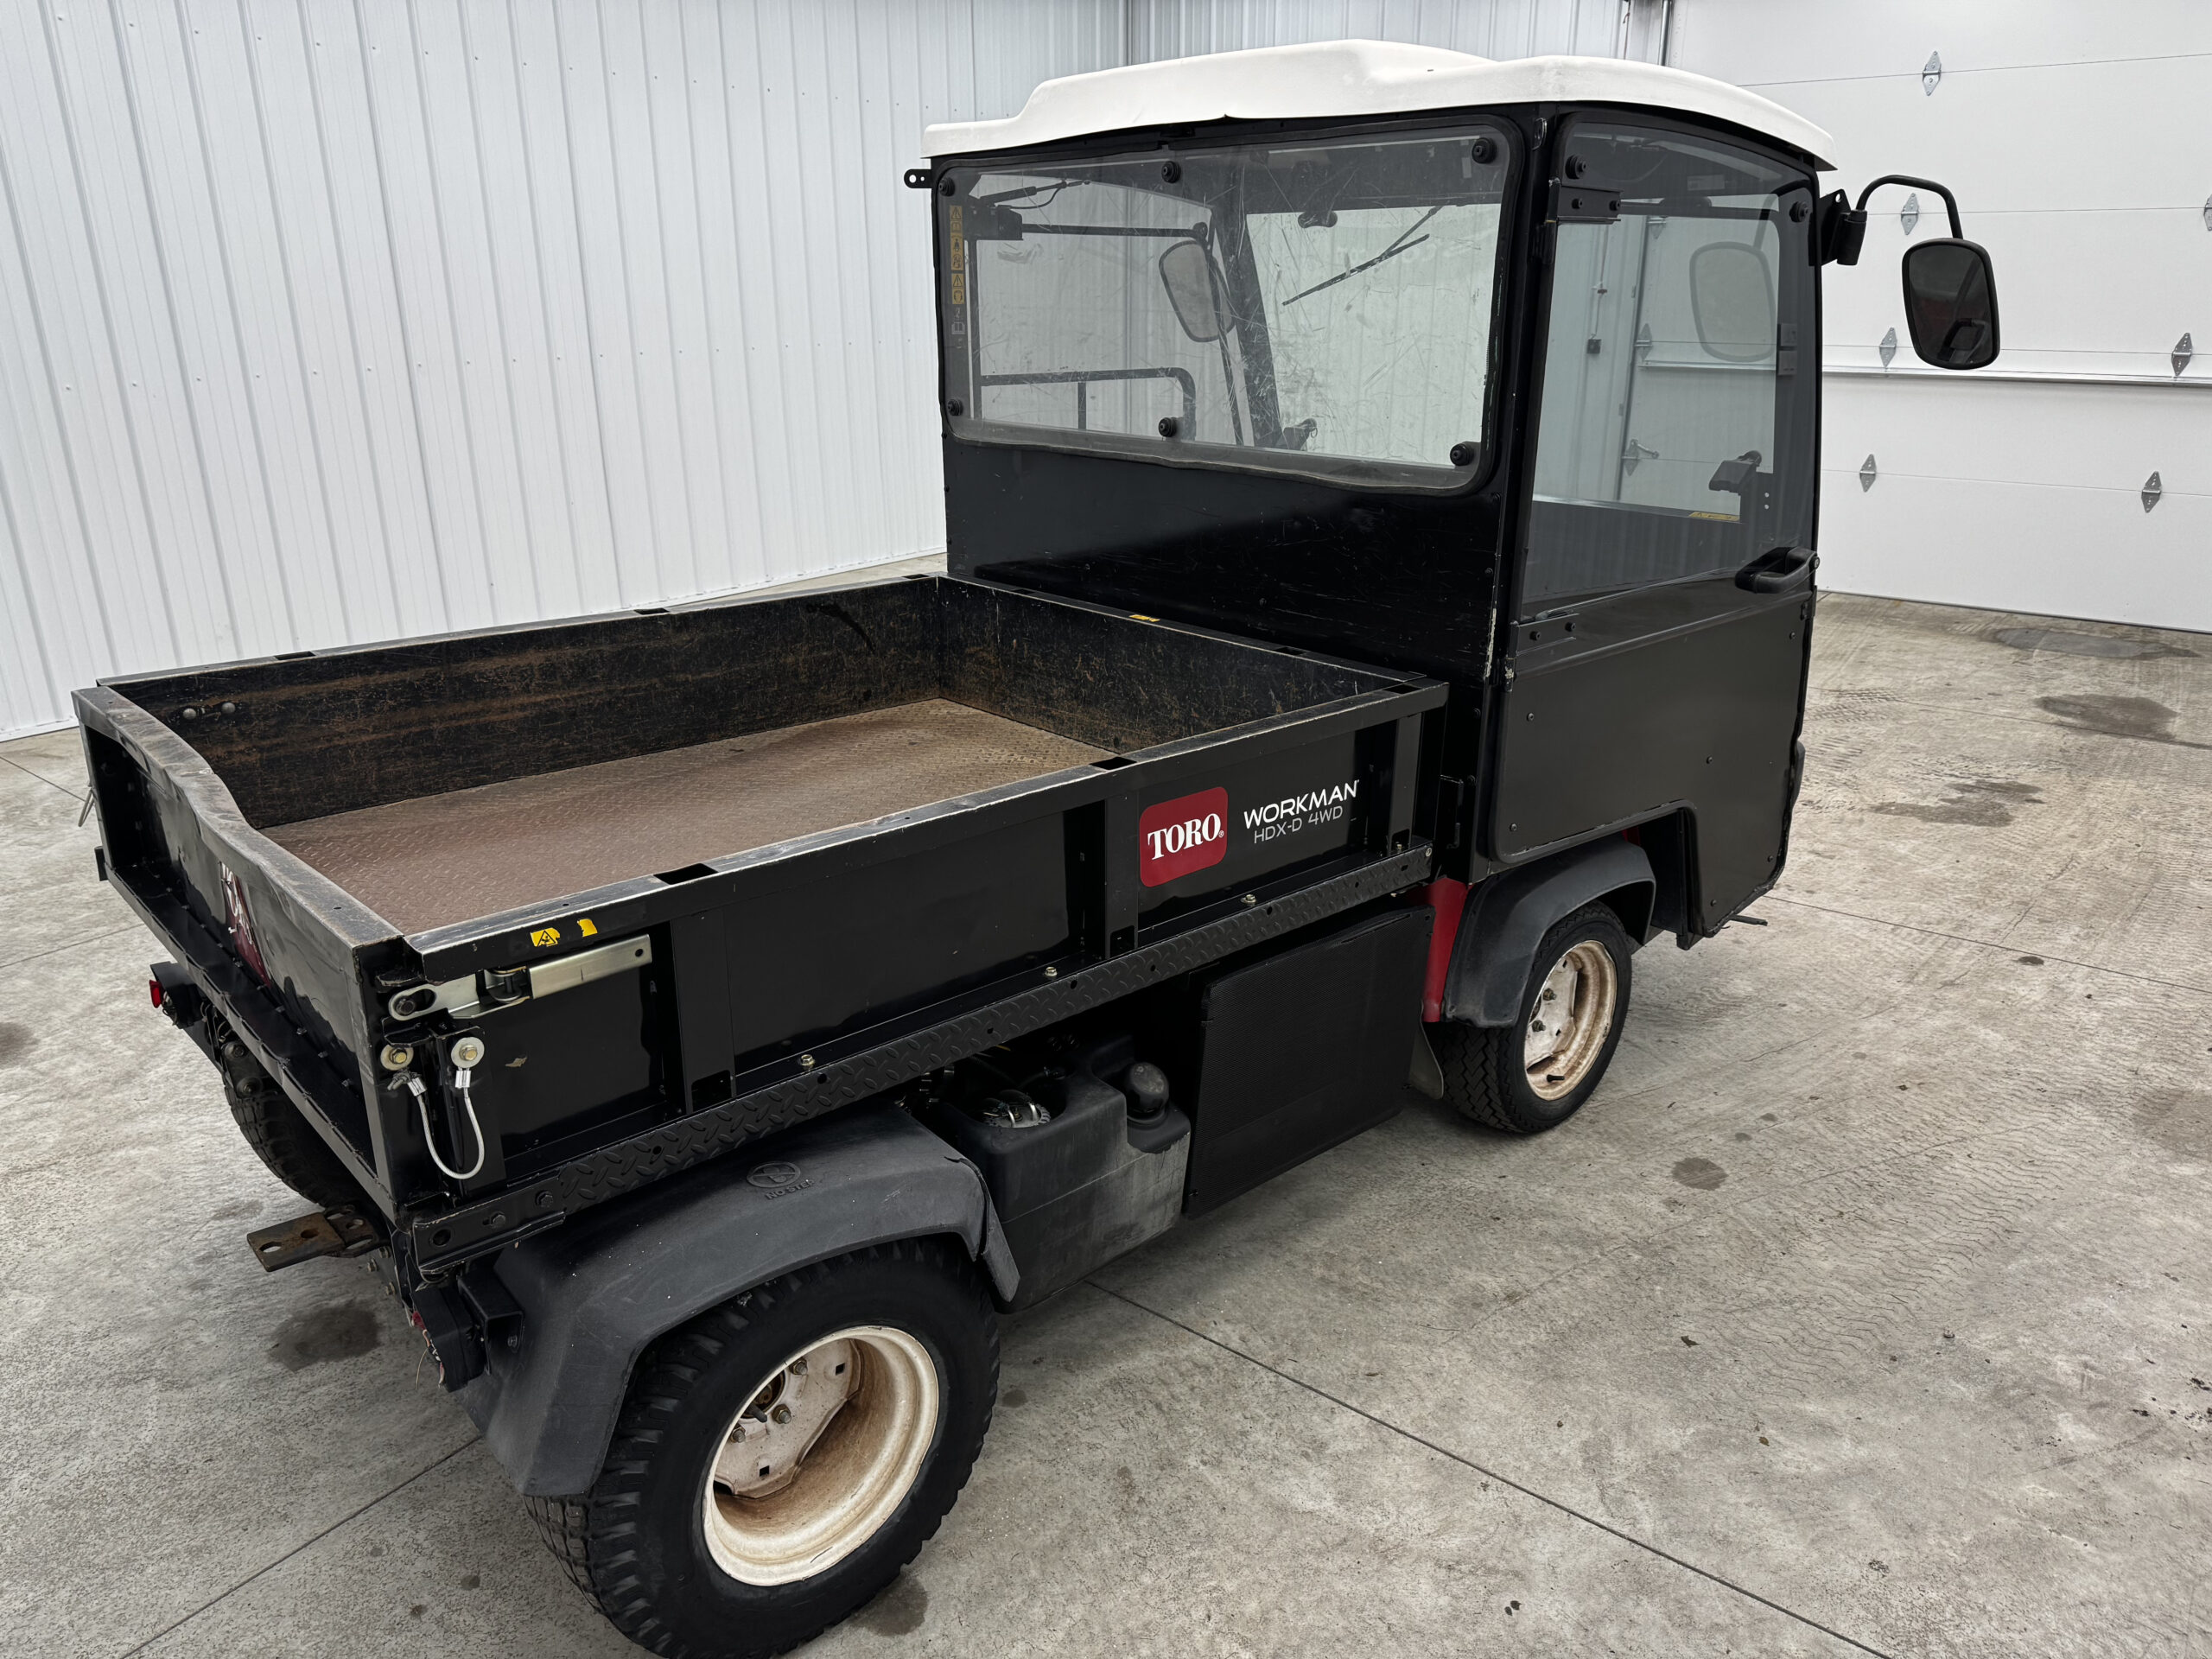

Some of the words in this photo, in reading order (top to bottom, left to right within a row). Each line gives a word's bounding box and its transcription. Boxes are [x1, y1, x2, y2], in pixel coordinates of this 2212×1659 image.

[1243, 782, 1357, 830] WORKMAN
[1254, 817, 1302, 844] HDX-D
[1308, 805, 1344, 825] 4WD
[1147, 813, 1221, 861] TORO
[765, 1190, 785, 1200] NO
